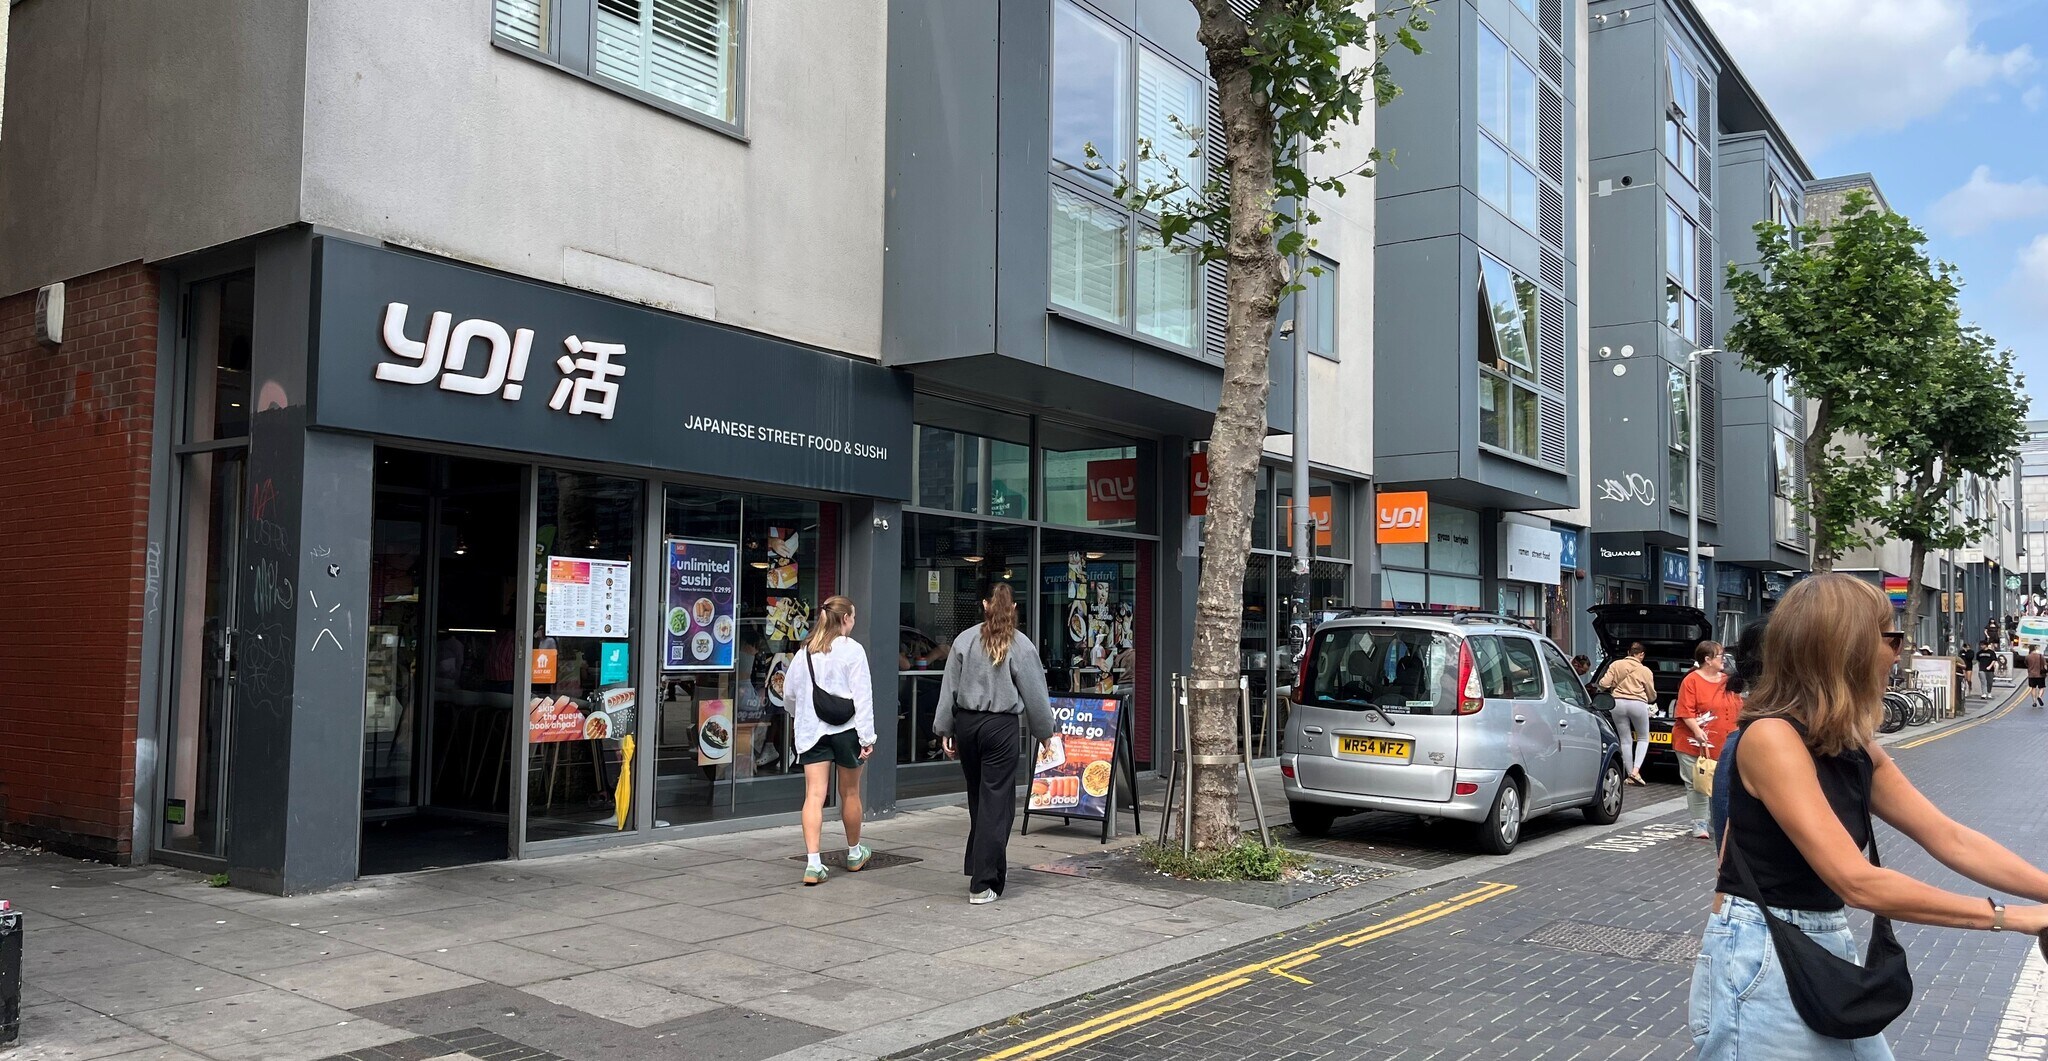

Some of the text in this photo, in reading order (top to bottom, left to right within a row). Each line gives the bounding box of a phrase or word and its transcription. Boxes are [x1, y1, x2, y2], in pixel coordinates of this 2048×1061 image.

[549, 334, 626, 420] 活
[684, 414, 888, 460] JAPANESE STREET FOOD & SUSHI
[1453, 534, 1469, 546] teriyaki
[676, 558, 730, 573] unlimited
[681, 573, 712, 587] sushi
[714, 586, 732, 594] £29.95
[537, 703, 555, 714] skip
[1051, 707, 1093, 722] YO! on
[543, 712, 584, 722] the queue
[530, 720, 576, 730] book ahead
[1061, 723, 1104, 740] the go
[1650, 733, 1668, 742] YUO
[1344, 738, 1404, 756] WR54 WFZ
